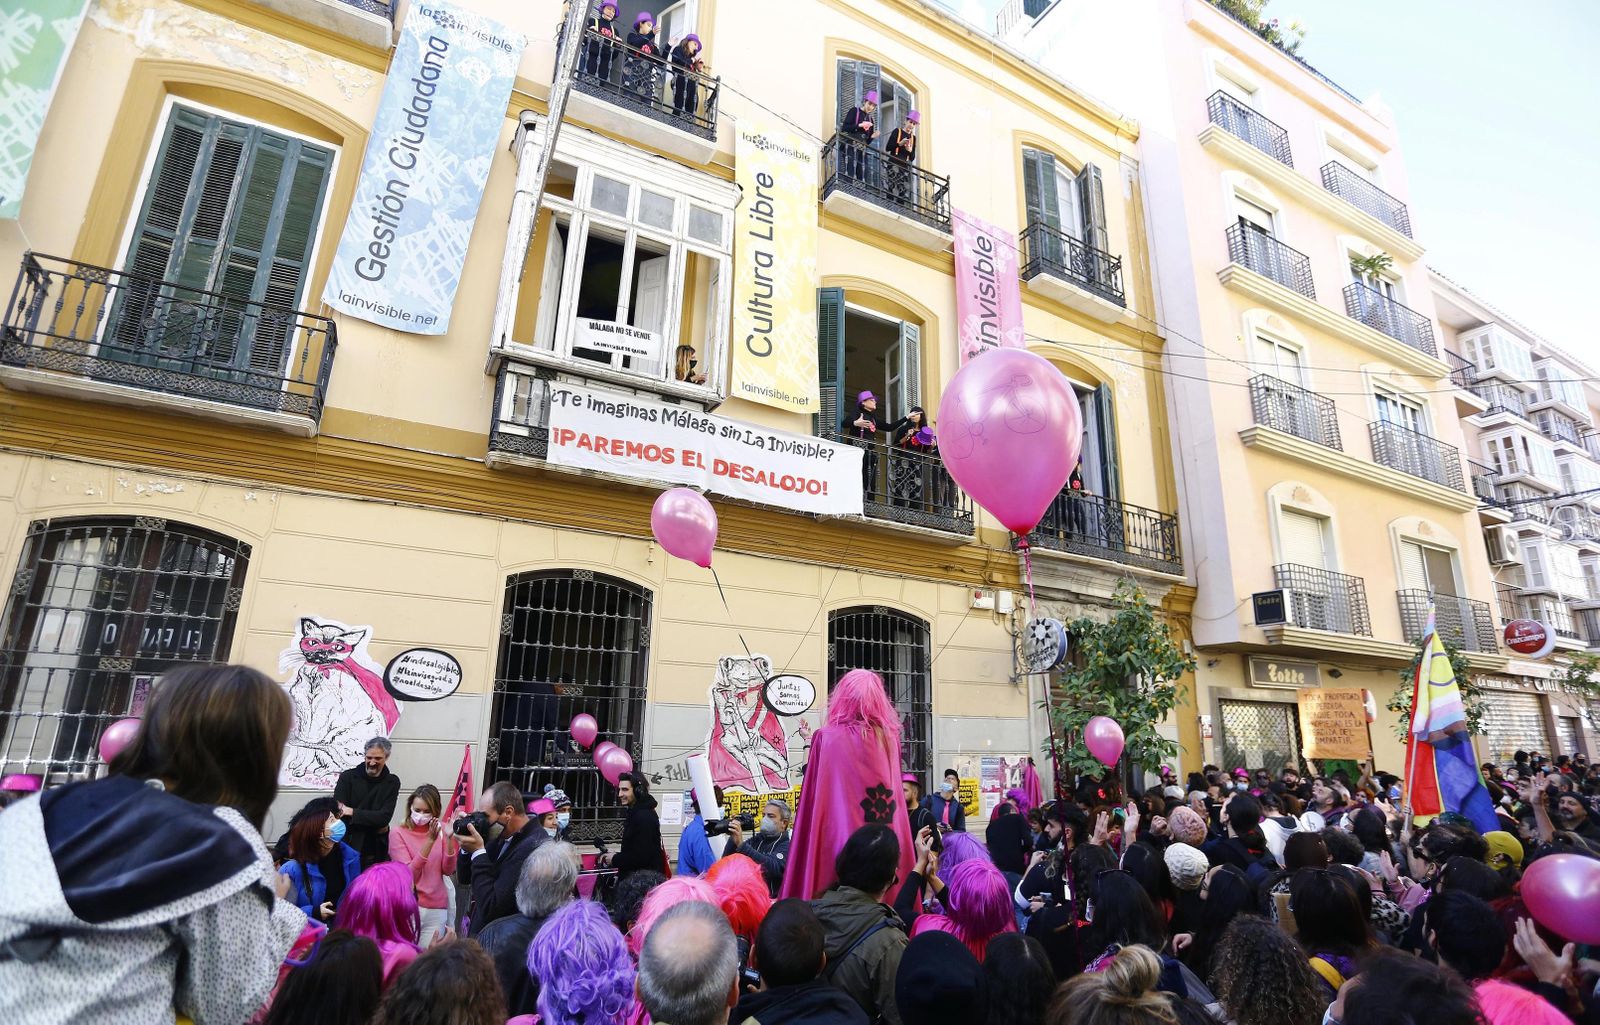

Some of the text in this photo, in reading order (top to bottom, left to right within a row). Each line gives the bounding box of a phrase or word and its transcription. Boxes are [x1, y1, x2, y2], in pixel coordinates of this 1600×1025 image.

[354, 35, 450, 282] Gestión Ciudadana
[769, 143, 811, 162] invisible
[745, 172, 774, 358] Cultura Libre
[338, 289, 439, 326] lainvisible.net
[972, 235, 999, 347] invisible
[589, 321, 652, 341] MÁLAGA NO SE VENDE
[741, 380, 809, 406] lainvisible.net
[551, 389, 835, 462] ¿Te imaginas Málaga sin La Invisible?
[552, 427, 828, 496] ¡PAREMOS EL DESALOJO!
[1506, 633, 1545, 645] Cruzcampo
[1004, 768, 1021, 789] 14
